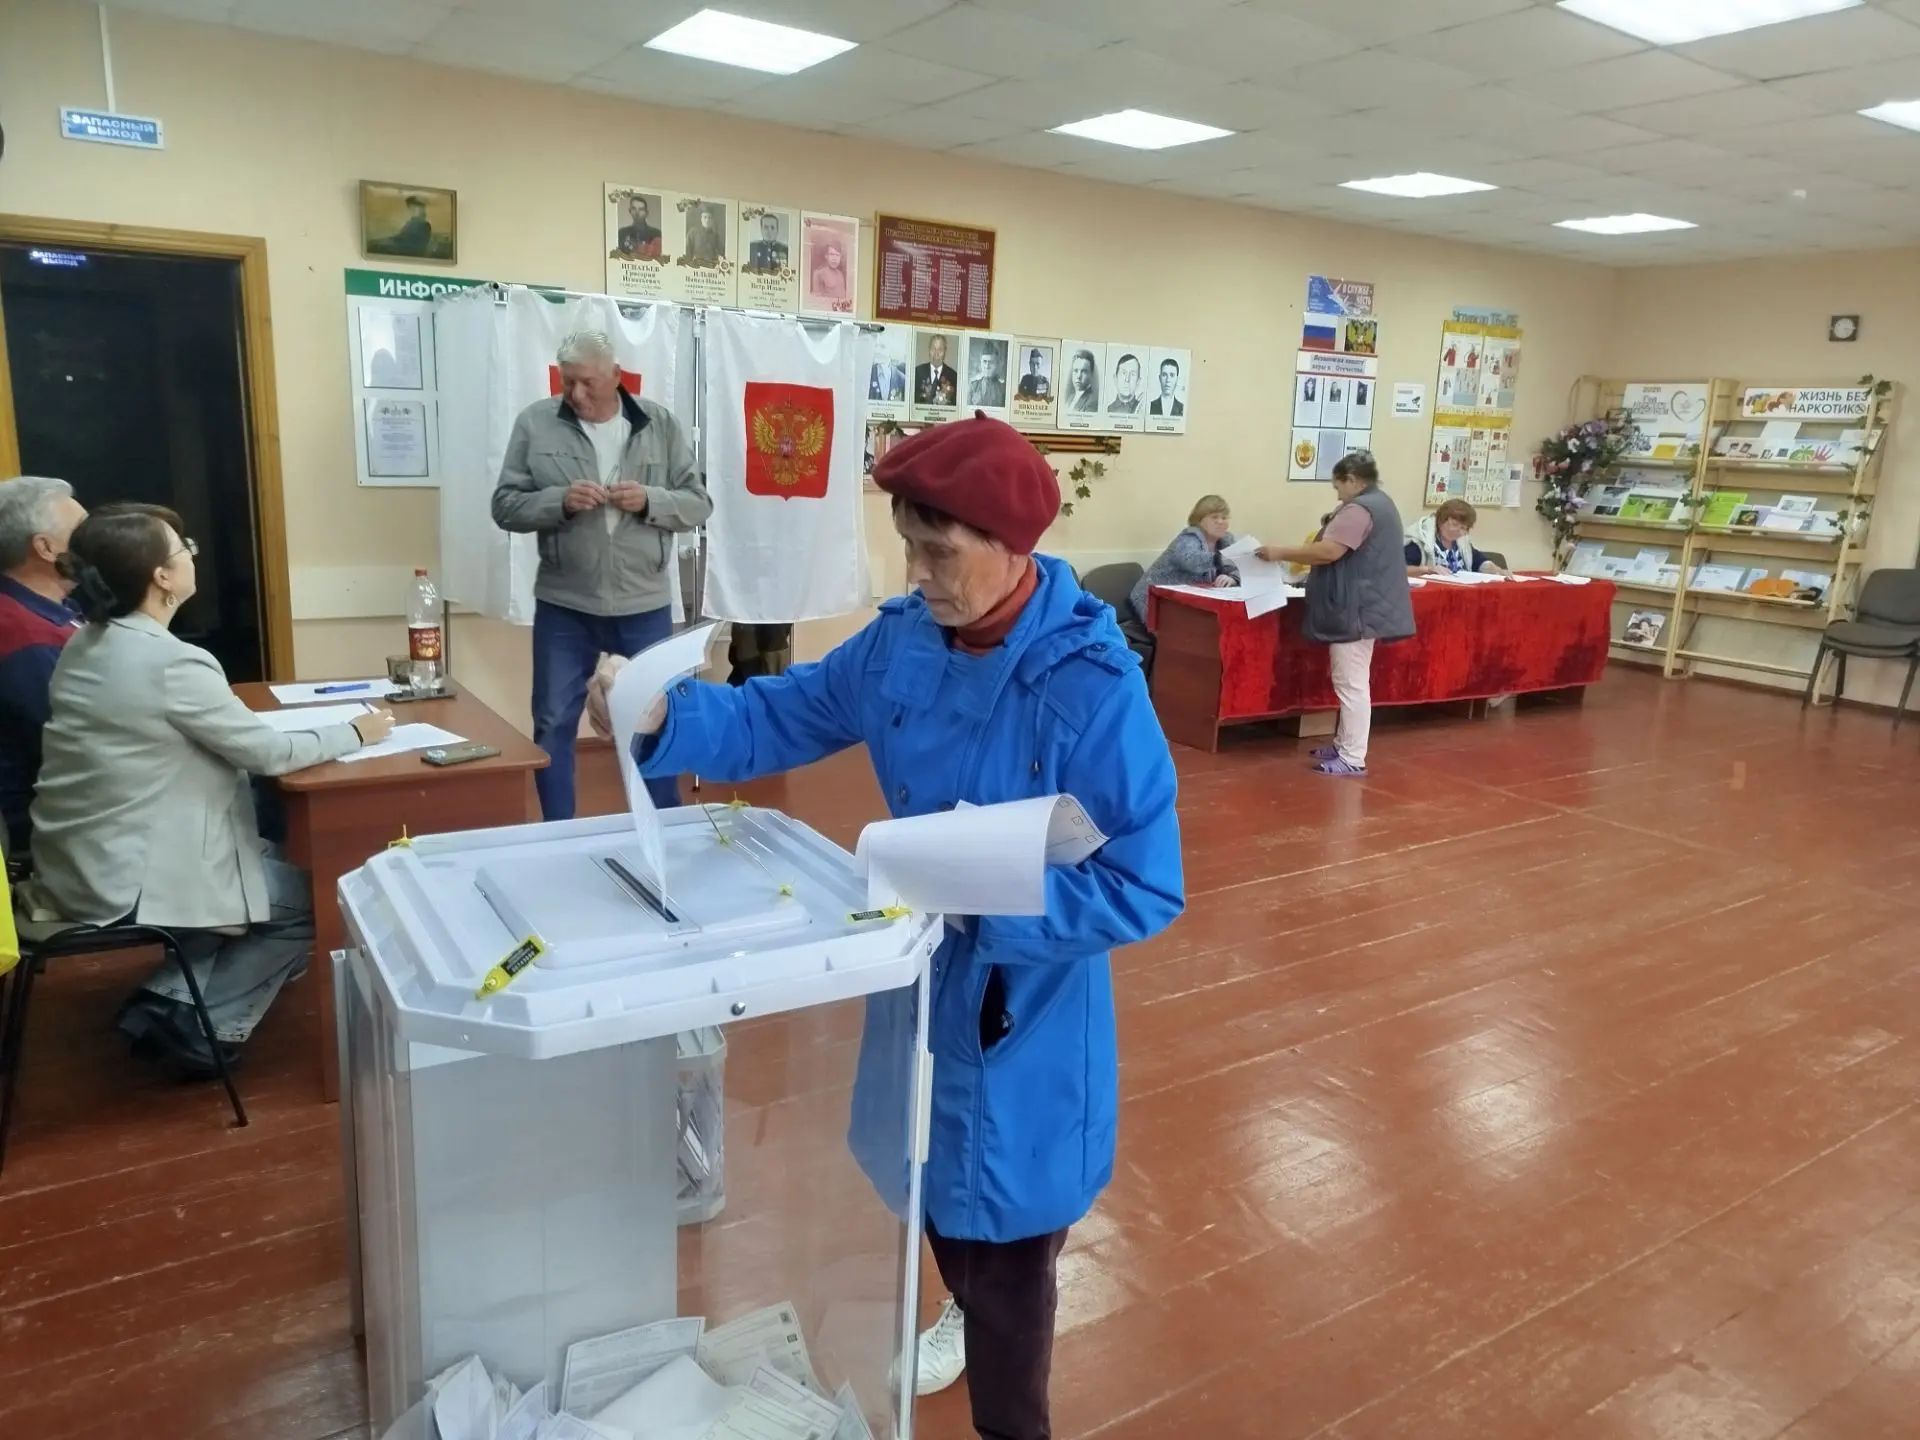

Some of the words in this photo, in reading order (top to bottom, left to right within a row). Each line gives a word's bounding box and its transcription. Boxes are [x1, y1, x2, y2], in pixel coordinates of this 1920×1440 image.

[71, 114, 155, 133] ЗАПАСНЫЙ
[86, 125, 142, 141] ВЫХОД
[379, 278, 467, 299] ИНФОР
[1799, 391, 1842, 401] ЖИЗНЬ
[1846, 391, 1868, 401] БЕЗ
